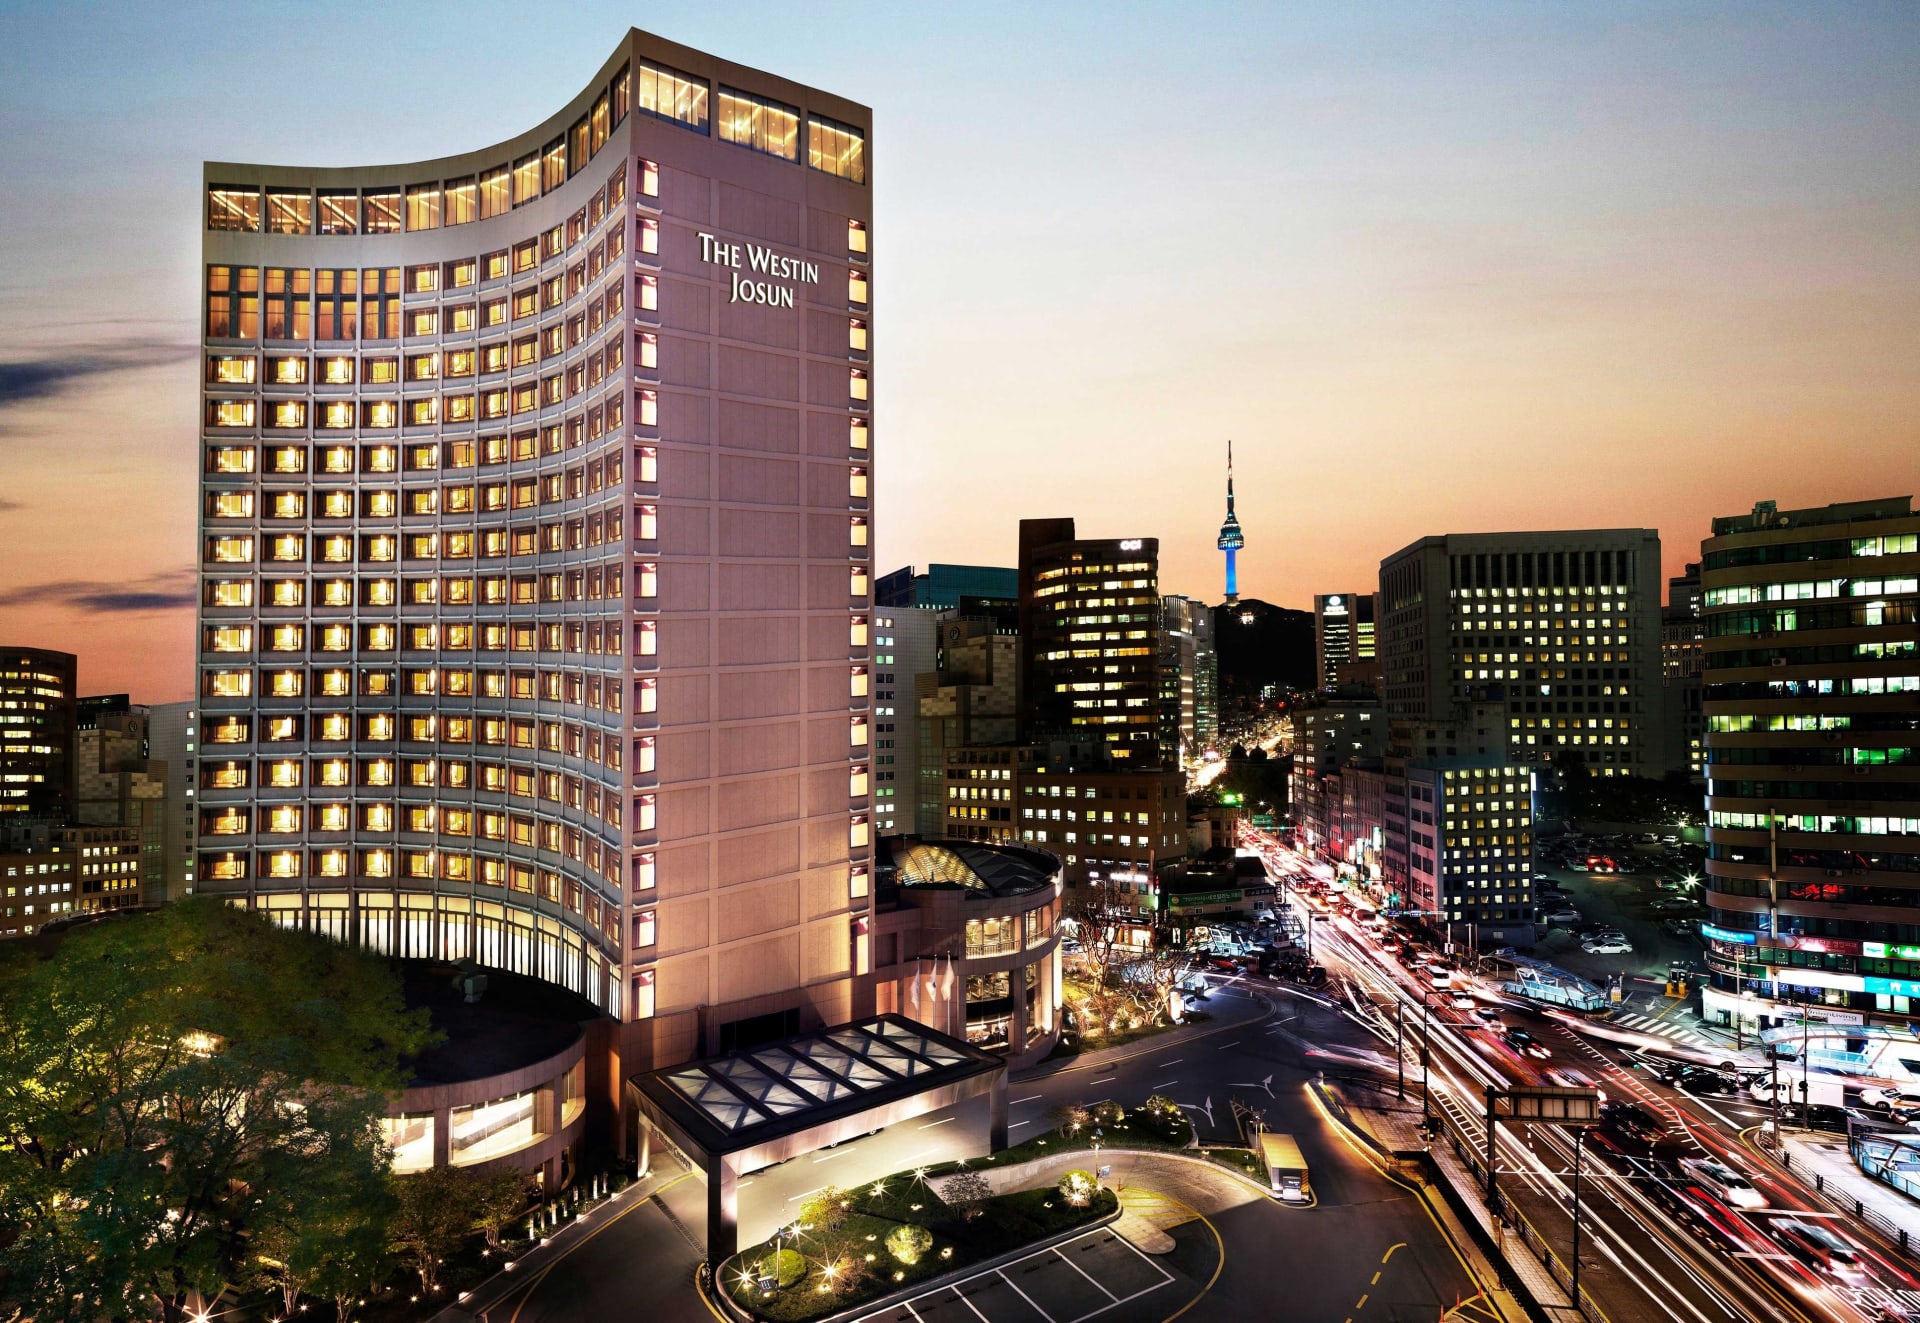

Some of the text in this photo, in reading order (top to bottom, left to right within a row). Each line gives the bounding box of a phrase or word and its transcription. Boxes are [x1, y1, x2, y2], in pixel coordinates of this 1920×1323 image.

[698, 232, 818, 284] THE WESTIN
[731, 272, 793, 308] JOSUN
